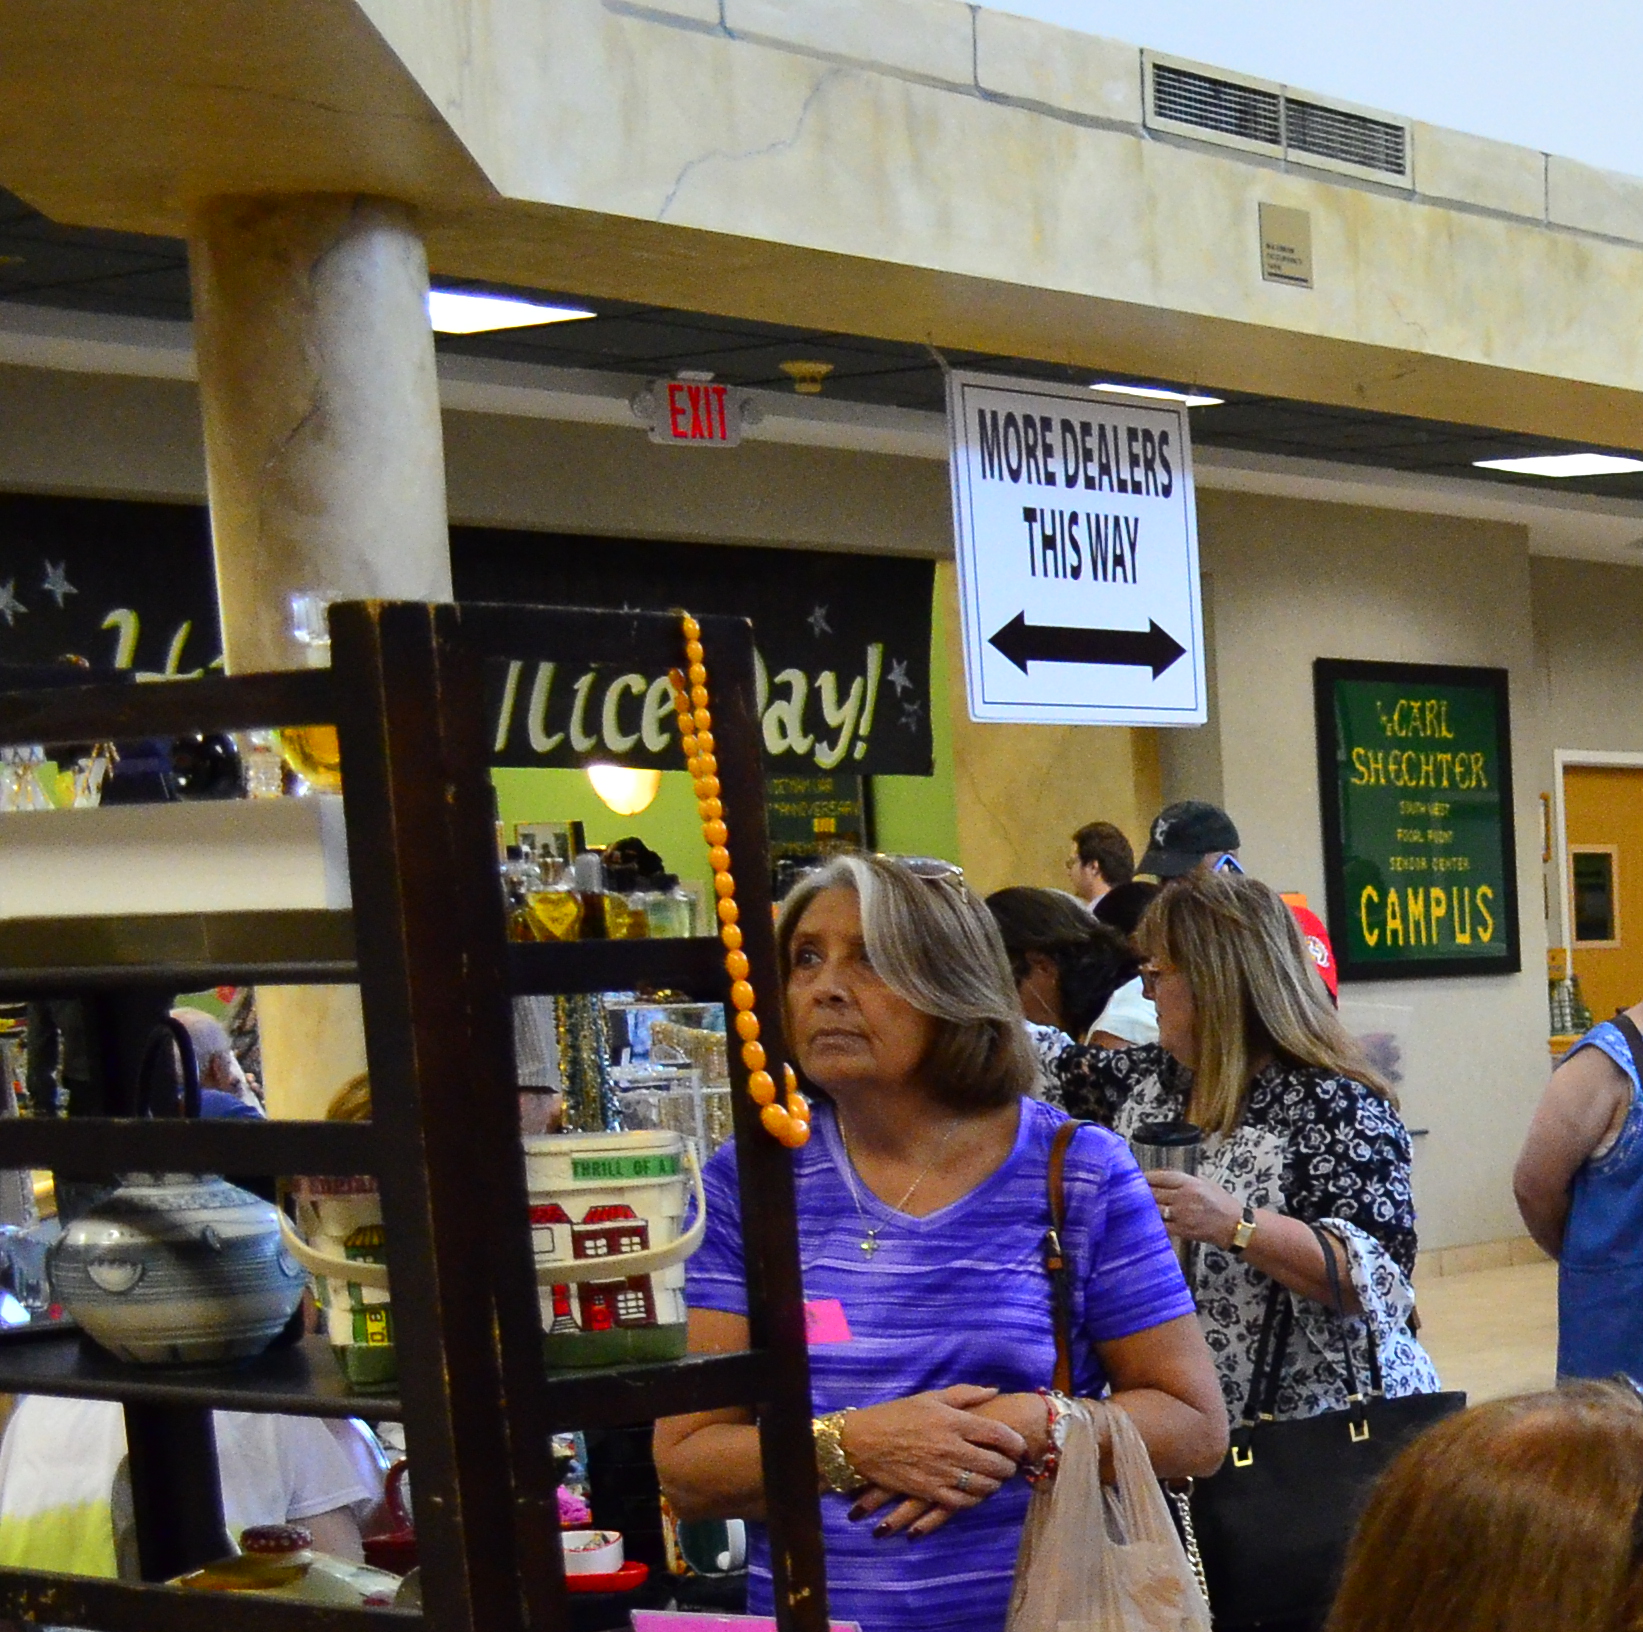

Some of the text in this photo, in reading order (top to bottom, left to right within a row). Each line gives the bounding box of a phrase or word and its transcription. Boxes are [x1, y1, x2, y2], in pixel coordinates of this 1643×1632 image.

[667, 383, 727, 441] EXIT
[977, 408, 1173, 499] MORE DEALERS
[1023, 506, 1139, 584] THIS WAY
[1393, 699, 1454, 738] CARL
[1351, 747, 1488, 789] SHECHTER
[1360, 884, 1494, 947] CAMPUS
[572, 1160, 624, 1180] THRILL
[632, 1158, 650, 1175] OF
